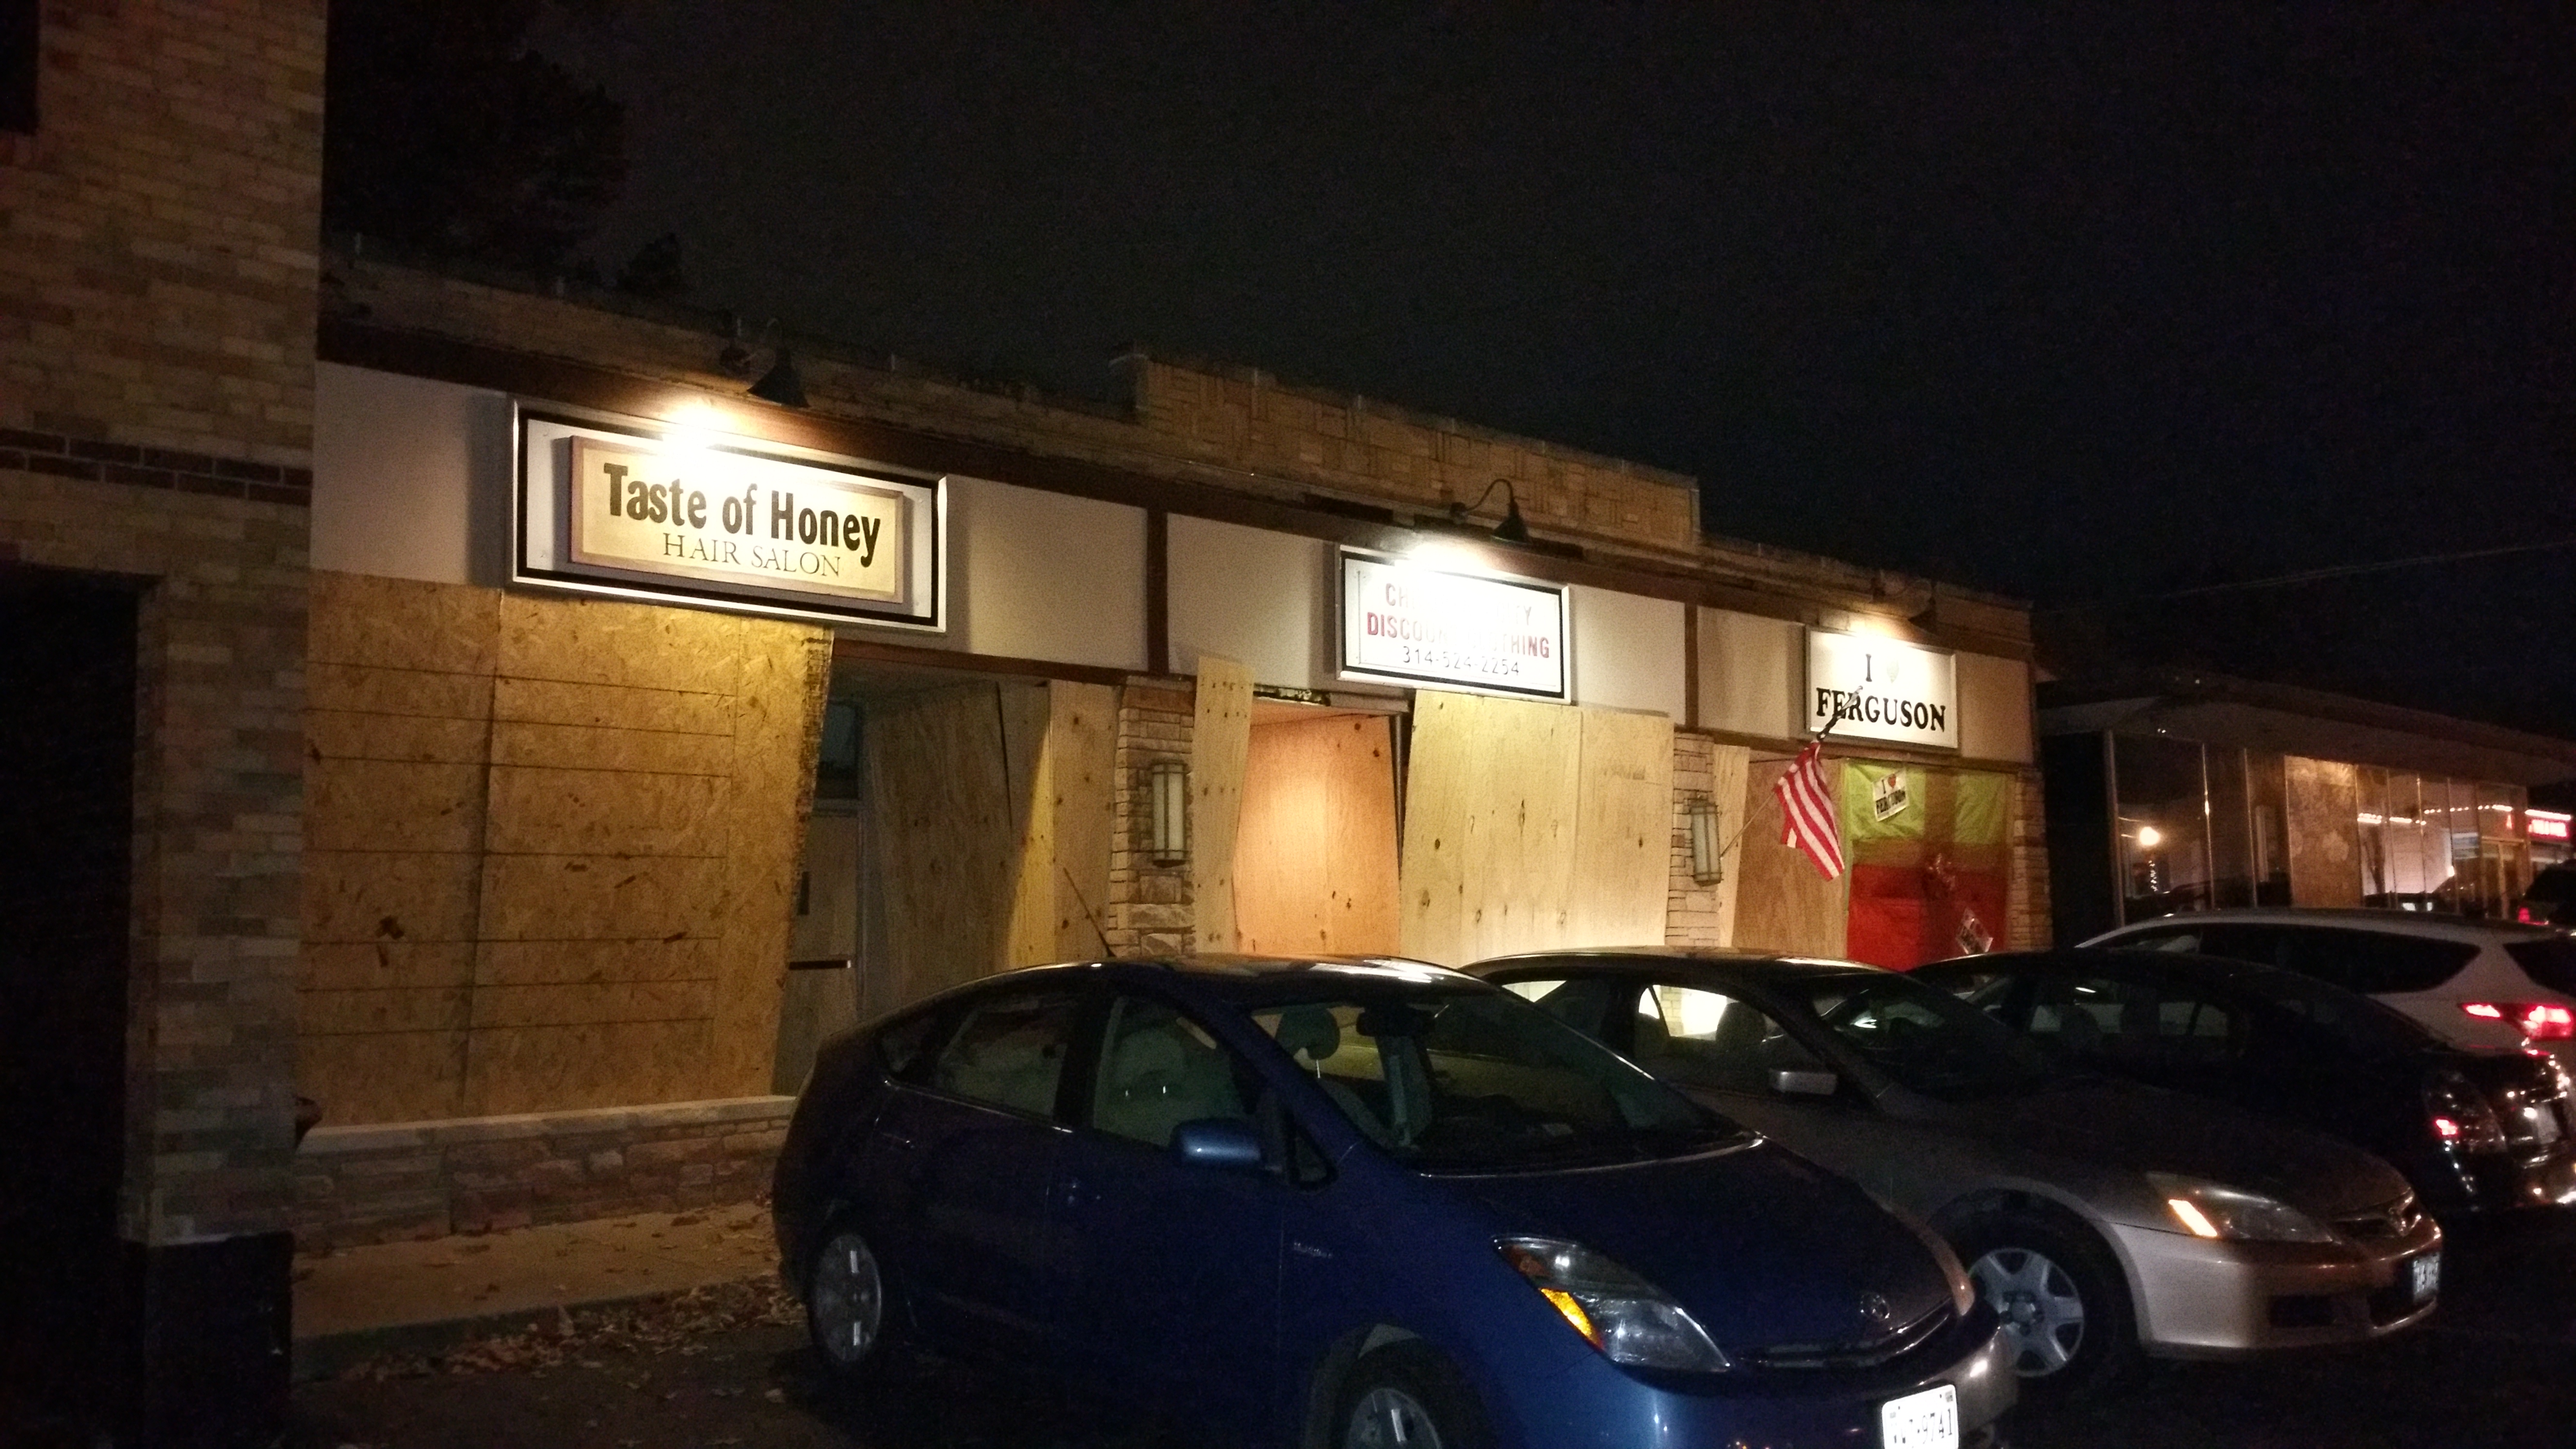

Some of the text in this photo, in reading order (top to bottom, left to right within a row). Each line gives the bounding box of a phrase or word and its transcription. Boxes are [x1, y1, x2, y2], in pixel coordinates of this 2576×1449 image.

[603, 462, 881, 567] Taste of Honey
[663, 532, 841, 577] HAIR SALON
[1402, 645, 1520, 676] 314-524-2254
[1865, 653, 1873, 682] I
[1816, 687, 1947, 732] FERGUSON
